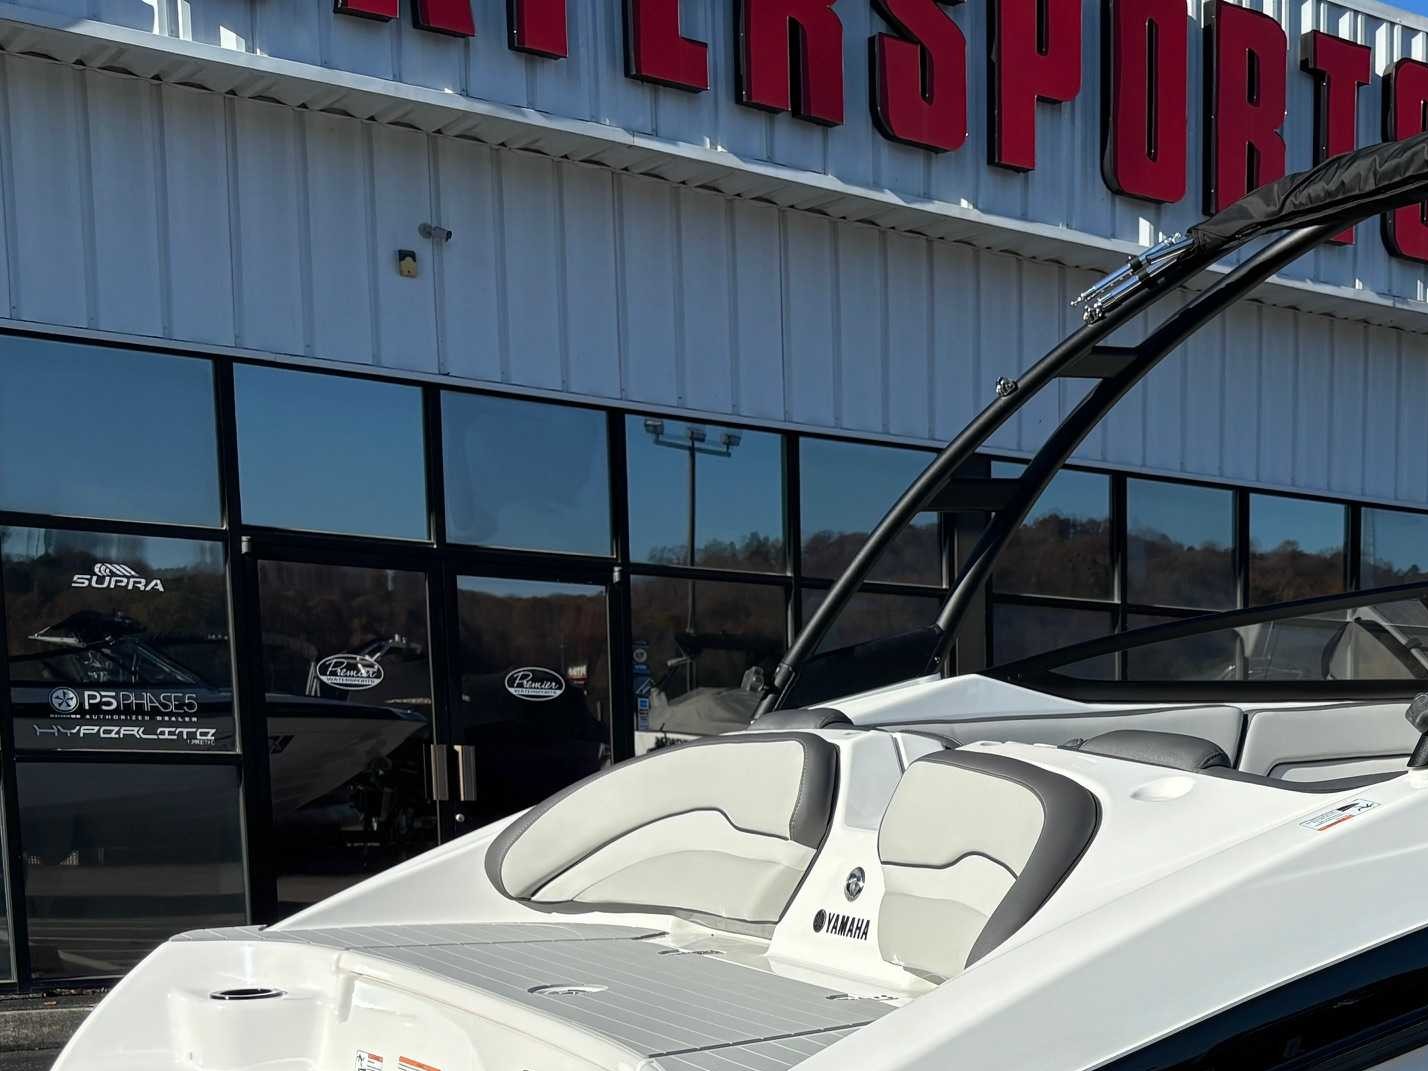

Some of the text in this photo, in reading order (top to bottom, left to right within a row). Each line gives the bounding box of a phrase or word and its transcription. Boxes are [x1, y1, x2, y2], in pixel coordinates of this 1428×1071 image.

[72, 574, 165, 592] SUPRA
[513, 671, 559, 689] Premier
[825, 911, 871, 941] YAMAHA
